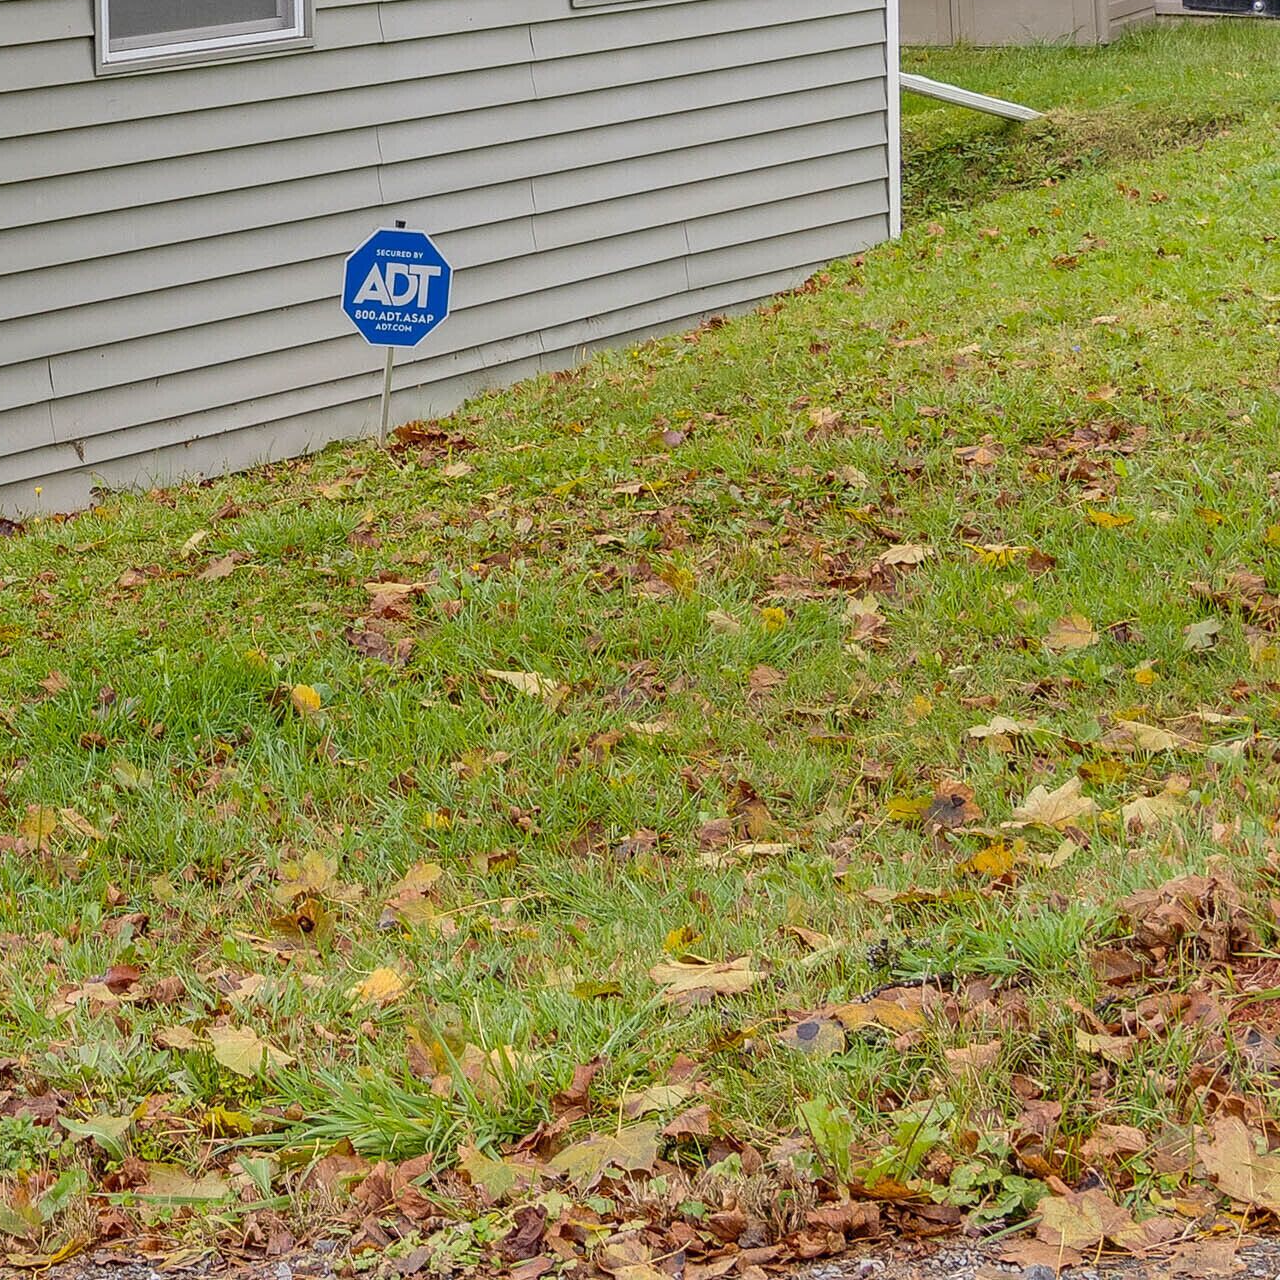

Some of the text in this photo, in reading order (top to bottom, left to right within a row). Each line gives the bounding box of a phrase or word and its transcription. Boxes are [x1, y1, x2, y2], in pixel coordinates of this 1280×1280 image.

[376, 249, 424, 259] SECURED BY
[352, 262, 442, 308] ADT
[355, 310, 434, 324] 800.ADT.ASAP
[375, 324, 412, 332] ADT.COM
